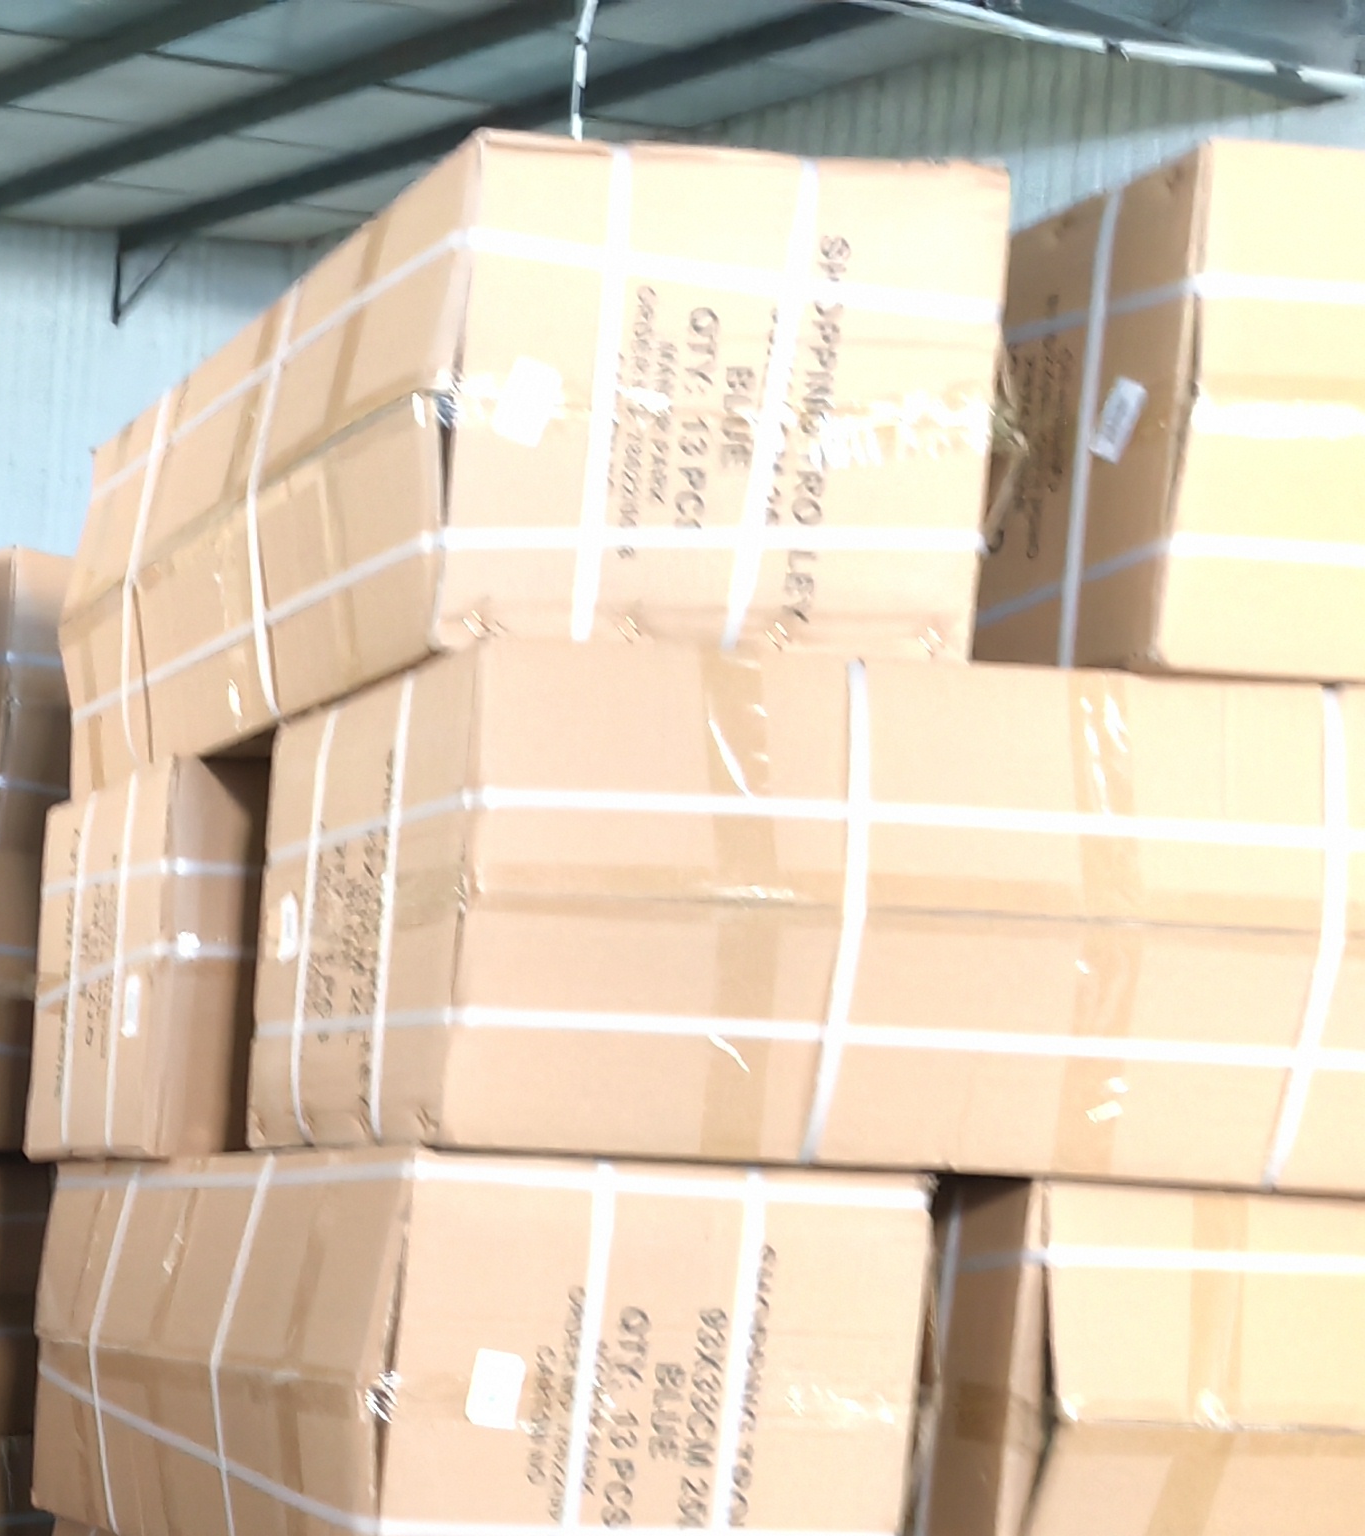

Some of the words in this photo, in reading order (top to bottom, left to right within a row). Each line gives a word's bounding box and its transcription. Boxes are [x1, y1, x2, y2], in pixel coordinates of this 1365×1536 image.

[678, 418, 709, 458] 13
[719, 366, 757, 477] BLUE
[607, 1410, 641, 1450] 13
[648, 1362, 687, 1462] BLUE
[600, 1457, 637, 1529] PCS
